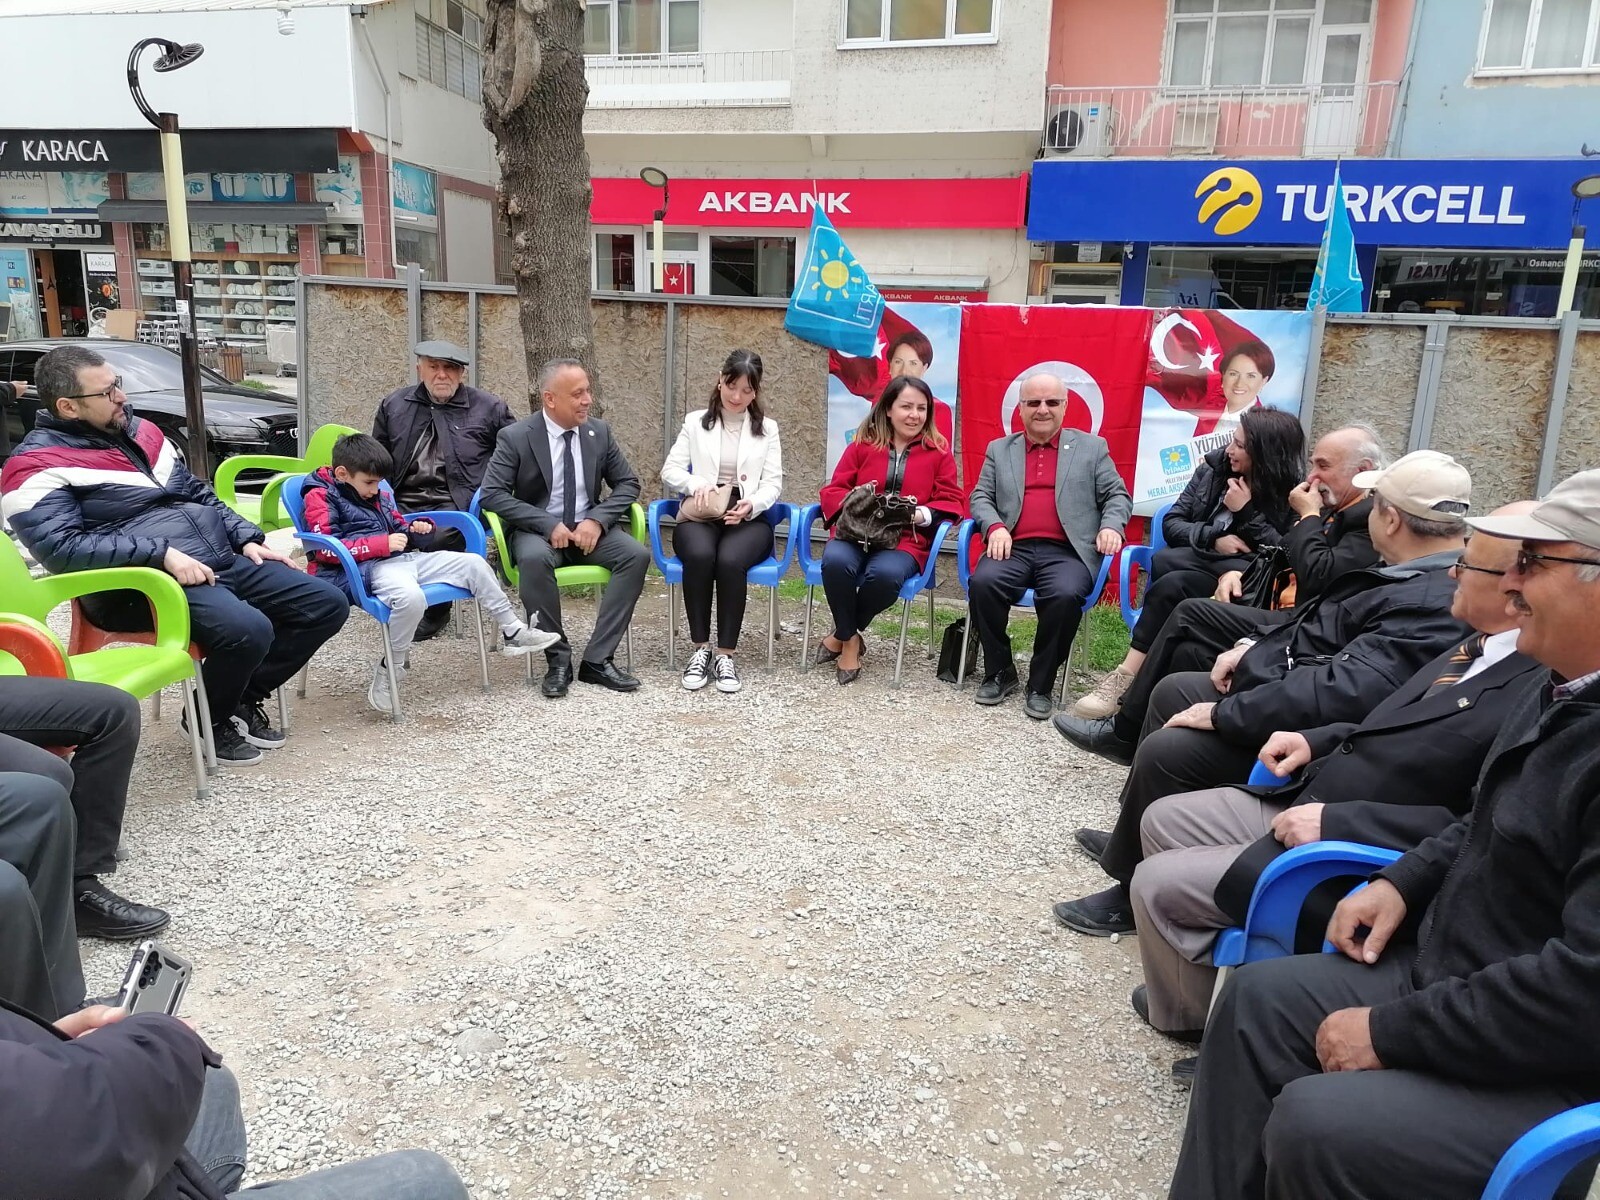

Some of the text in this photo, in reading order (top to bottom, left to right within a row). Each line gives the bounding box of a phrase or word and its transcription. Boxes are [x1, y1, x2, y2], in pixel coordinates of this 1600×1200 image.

[22, 140, 109, 161] KARACA
[698, 191, 851, 214] AKBANK
[1276, 184, 1526, 224] TURKCELL
[1147, 486, 1168, 498] MERAL
